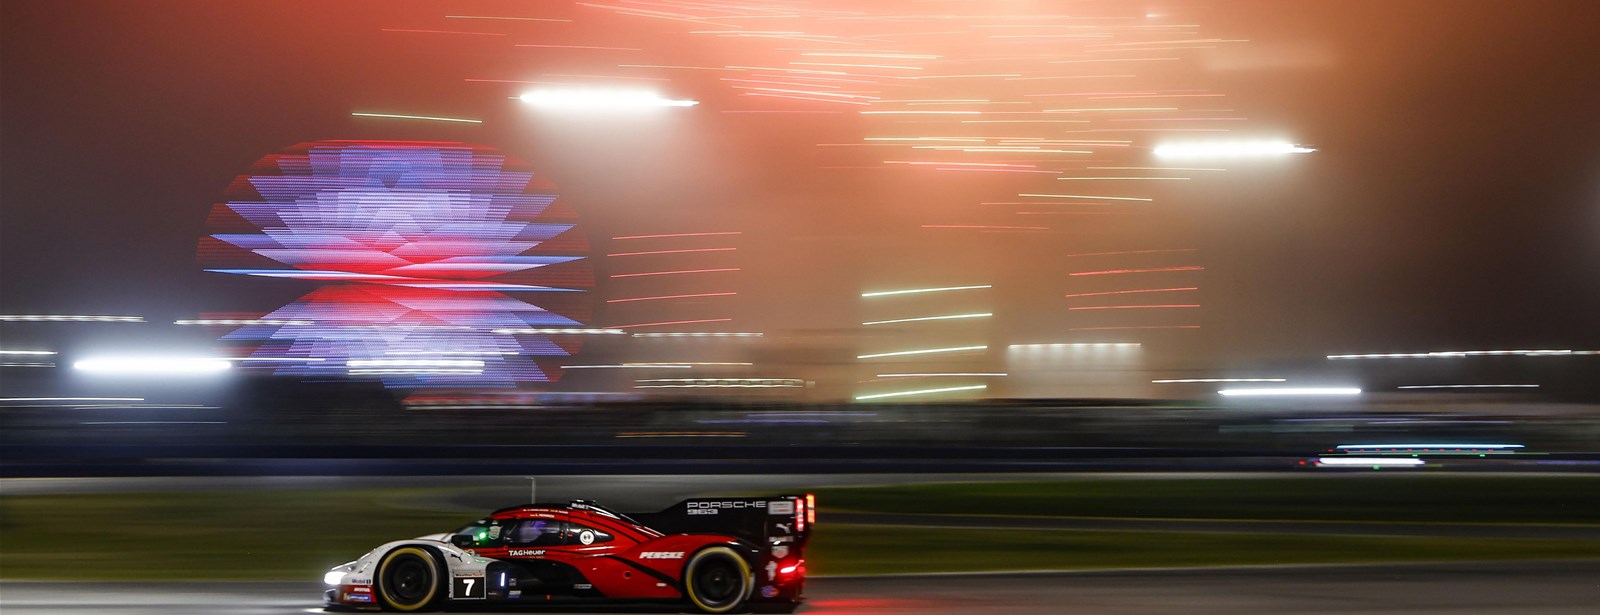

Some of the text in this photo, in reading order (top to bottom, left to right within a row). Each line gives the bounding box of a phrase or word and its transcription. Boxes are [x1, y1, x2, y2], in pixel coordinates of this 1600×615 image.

[687, 500, 767, 509] PORSCHE
[639, 551, 686, 559] PENSKE
[463, 578, 475, 597] 7
